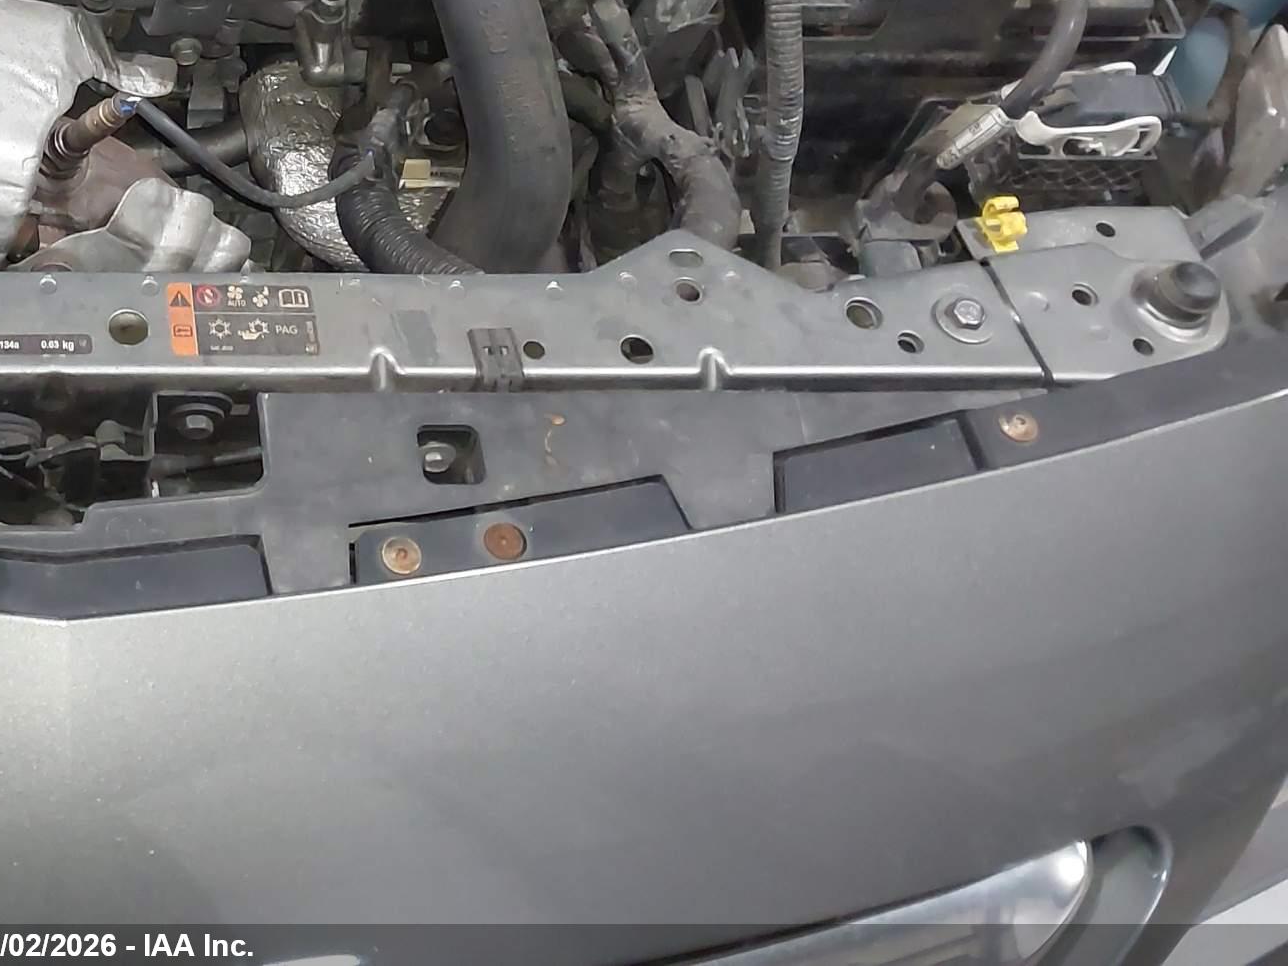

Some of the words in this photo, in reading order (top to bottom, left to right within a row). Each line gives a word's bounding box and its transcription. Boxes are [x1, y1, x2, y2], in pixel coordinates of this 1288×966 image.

[227, 299, 246, 307] AUTO
[275, 324, 298, 334] PAG
[62, 340, 75, 352] kg
